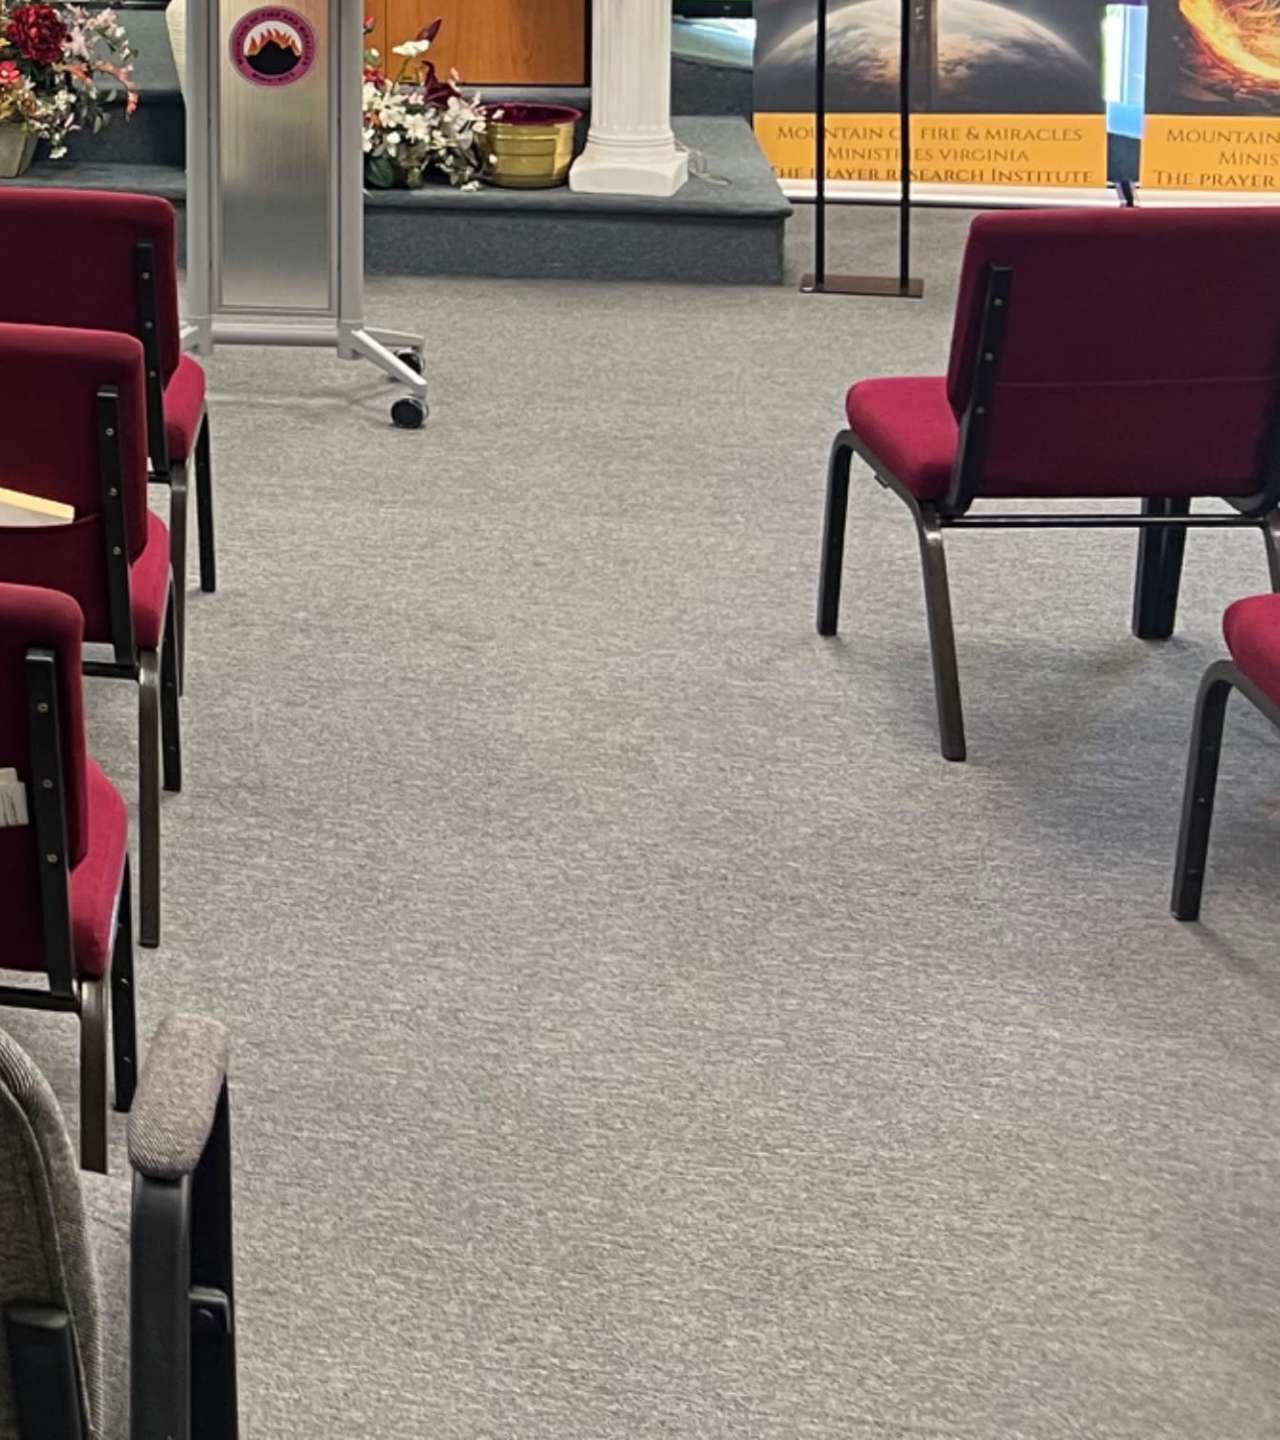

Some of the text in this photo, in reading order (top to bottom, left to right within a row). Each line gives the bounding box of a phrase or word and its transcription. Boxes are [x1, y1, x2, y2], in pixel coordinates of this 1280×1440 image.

[776, 126, 883, 140] MONTAIN
[921, 127, 961, 141] FIRE
[966, 126, 979, 141] &
[985, 128, 1083, 142] MIRACLES
[827, 147, 1030, 162] MINISTES VIRGINIA
[1219, 151, 1280, 167] MINIS
[886, 167, 983, 182] RSEARCH
[992, 167, 1093, 184] INSTITUTE
[1153, 169, 1275, 188] THE PRAYER
